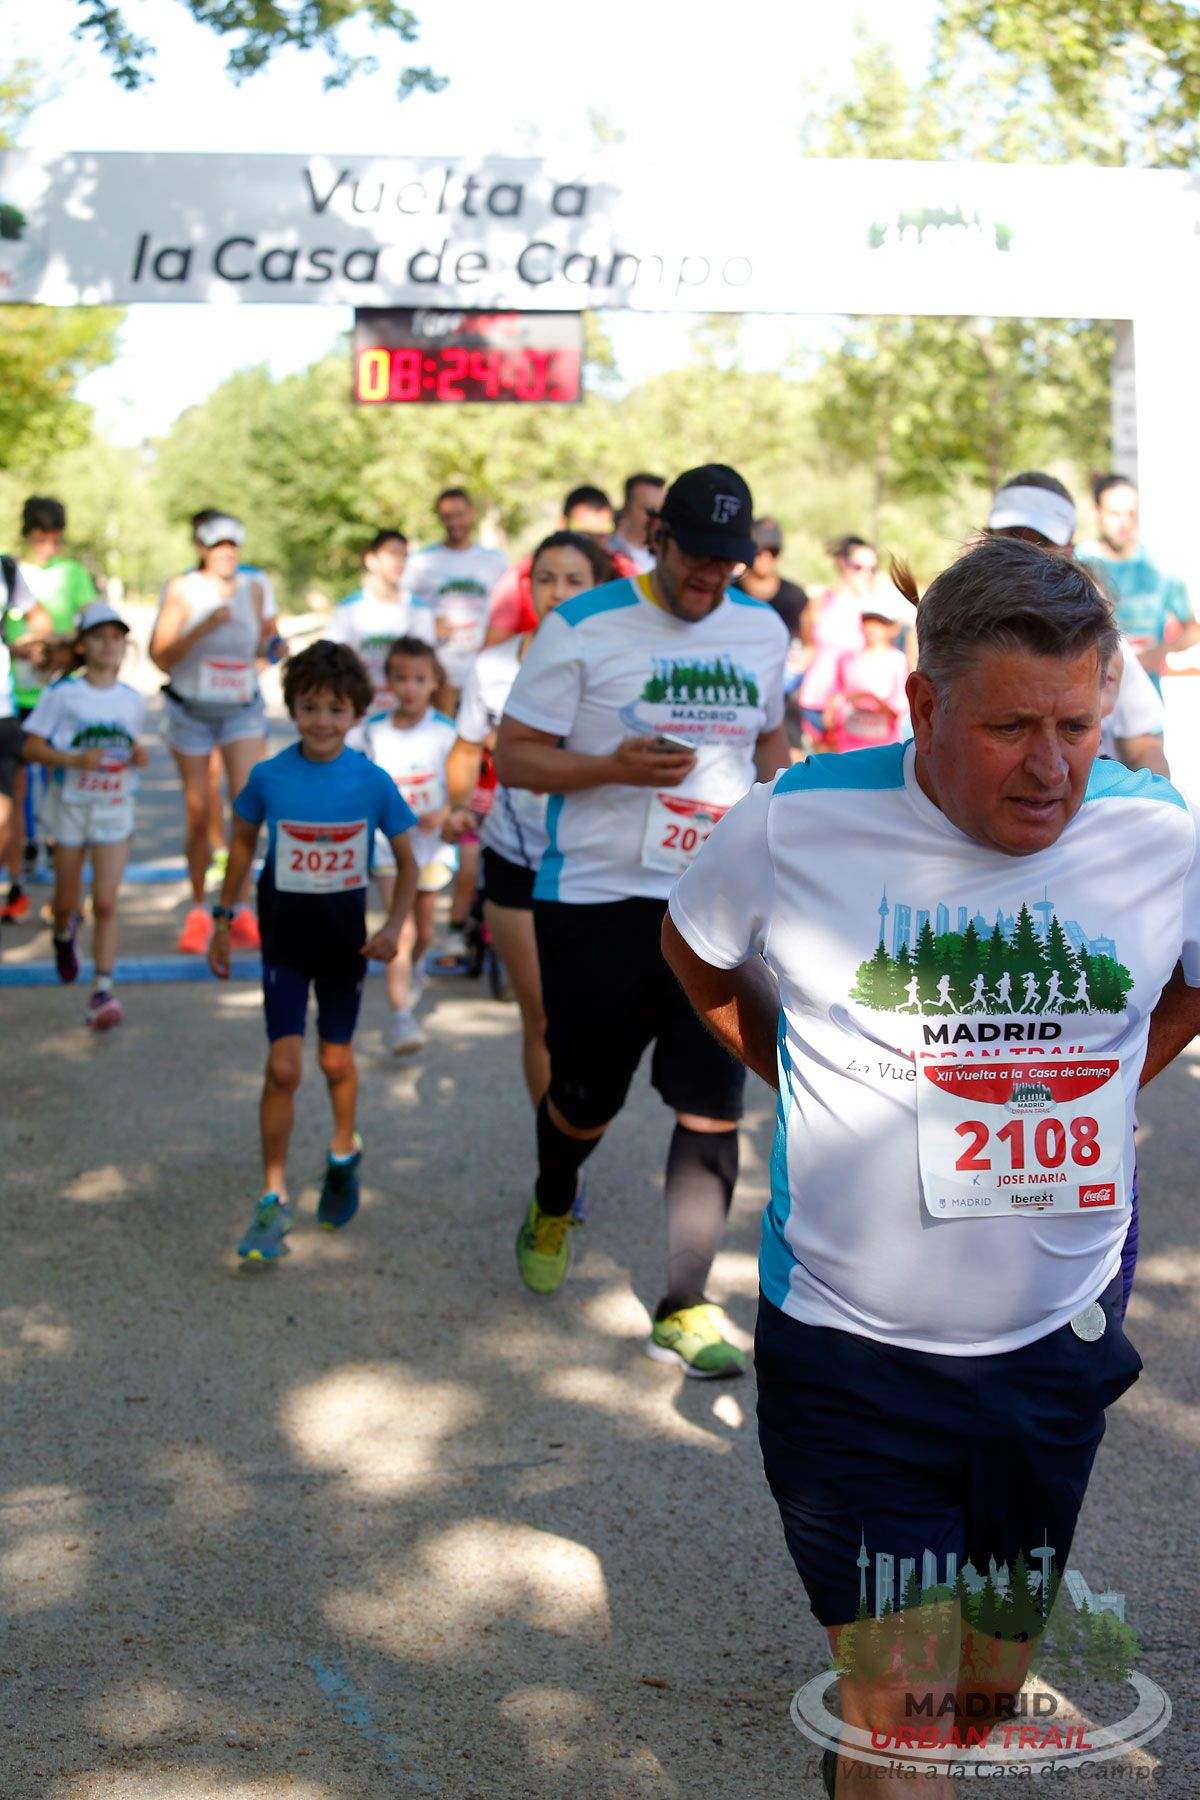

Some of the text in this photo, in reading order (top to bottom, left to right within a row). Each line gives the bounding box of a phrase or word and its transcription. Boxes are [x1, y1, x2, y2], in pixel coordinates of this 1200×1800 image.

[302, 168, 590, 218] Vuelta a
[130, 234, 754, 298] la Casa de Campo
[661, 824, 710, 851] 20
[291, 848, 355, 872] 2022
[922, 1022, 1062, 1045] MADRID
[878, 1063, 917, 1082] Vue
[956, 1070, 996, 1081] Vuelta
[1000, 1072, 1009, 1080] a
[1011, 1069, 1023, 1079] la
[1029, 1068, 1058, 1079] Casa
[1061, 1066, 1075, 1078] de
[954, 1116, 1101, 1171] 2108
[997, 1172, 1067, 1188] JOSE MARIA
[952, 1198, 992, 1207] MADRID
[1011, 1193, 1054, 1204] Iberext
